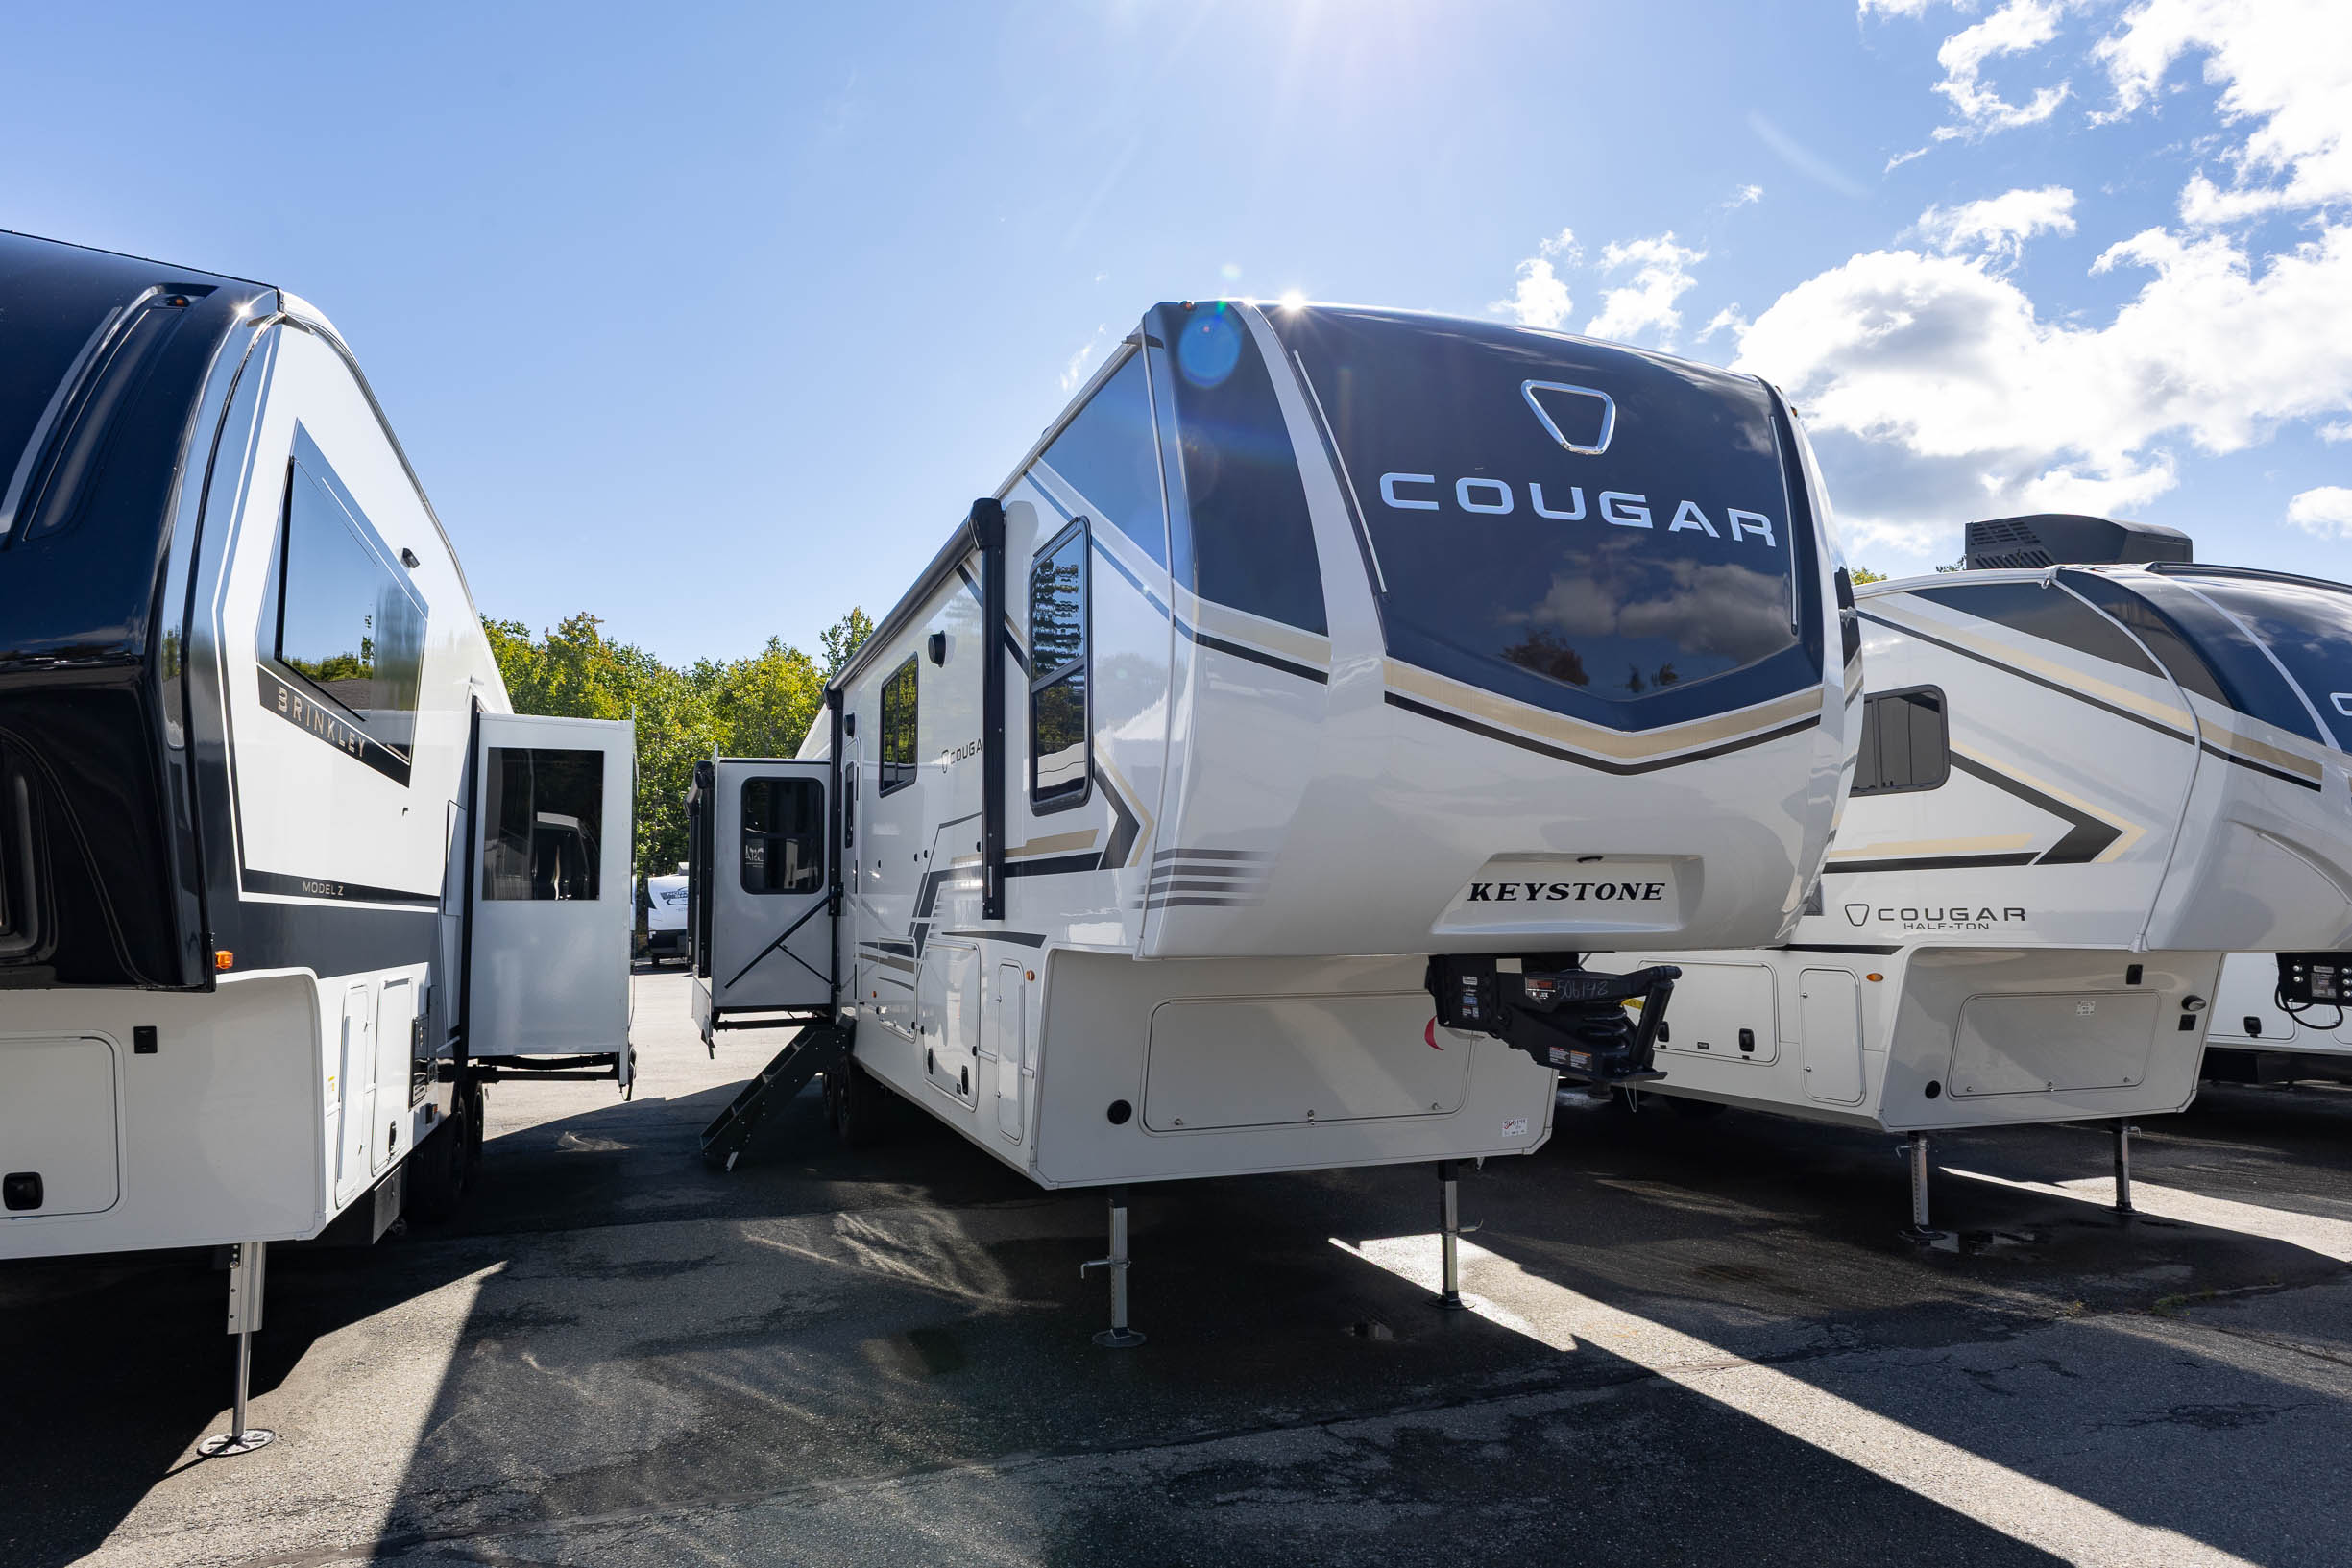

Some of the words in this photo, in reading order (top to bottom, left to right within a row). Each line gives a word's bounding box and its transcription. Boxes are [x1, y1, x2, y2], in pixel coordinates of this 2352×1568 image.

[1379, 472, 1777, 547] COUGAR
[277, 686, 366, 758] BRINKLEY
[950, 737, 982, 765] COUGA
[302, 881, 336, 896] MODEL
[337, 885, 345, 896] Z
[1467, 882, 1666, 902] KEYSTONE
[1877, 907, 2026, 922] COUGAR
[1903, 922, 1990, 930] HALF-TON
